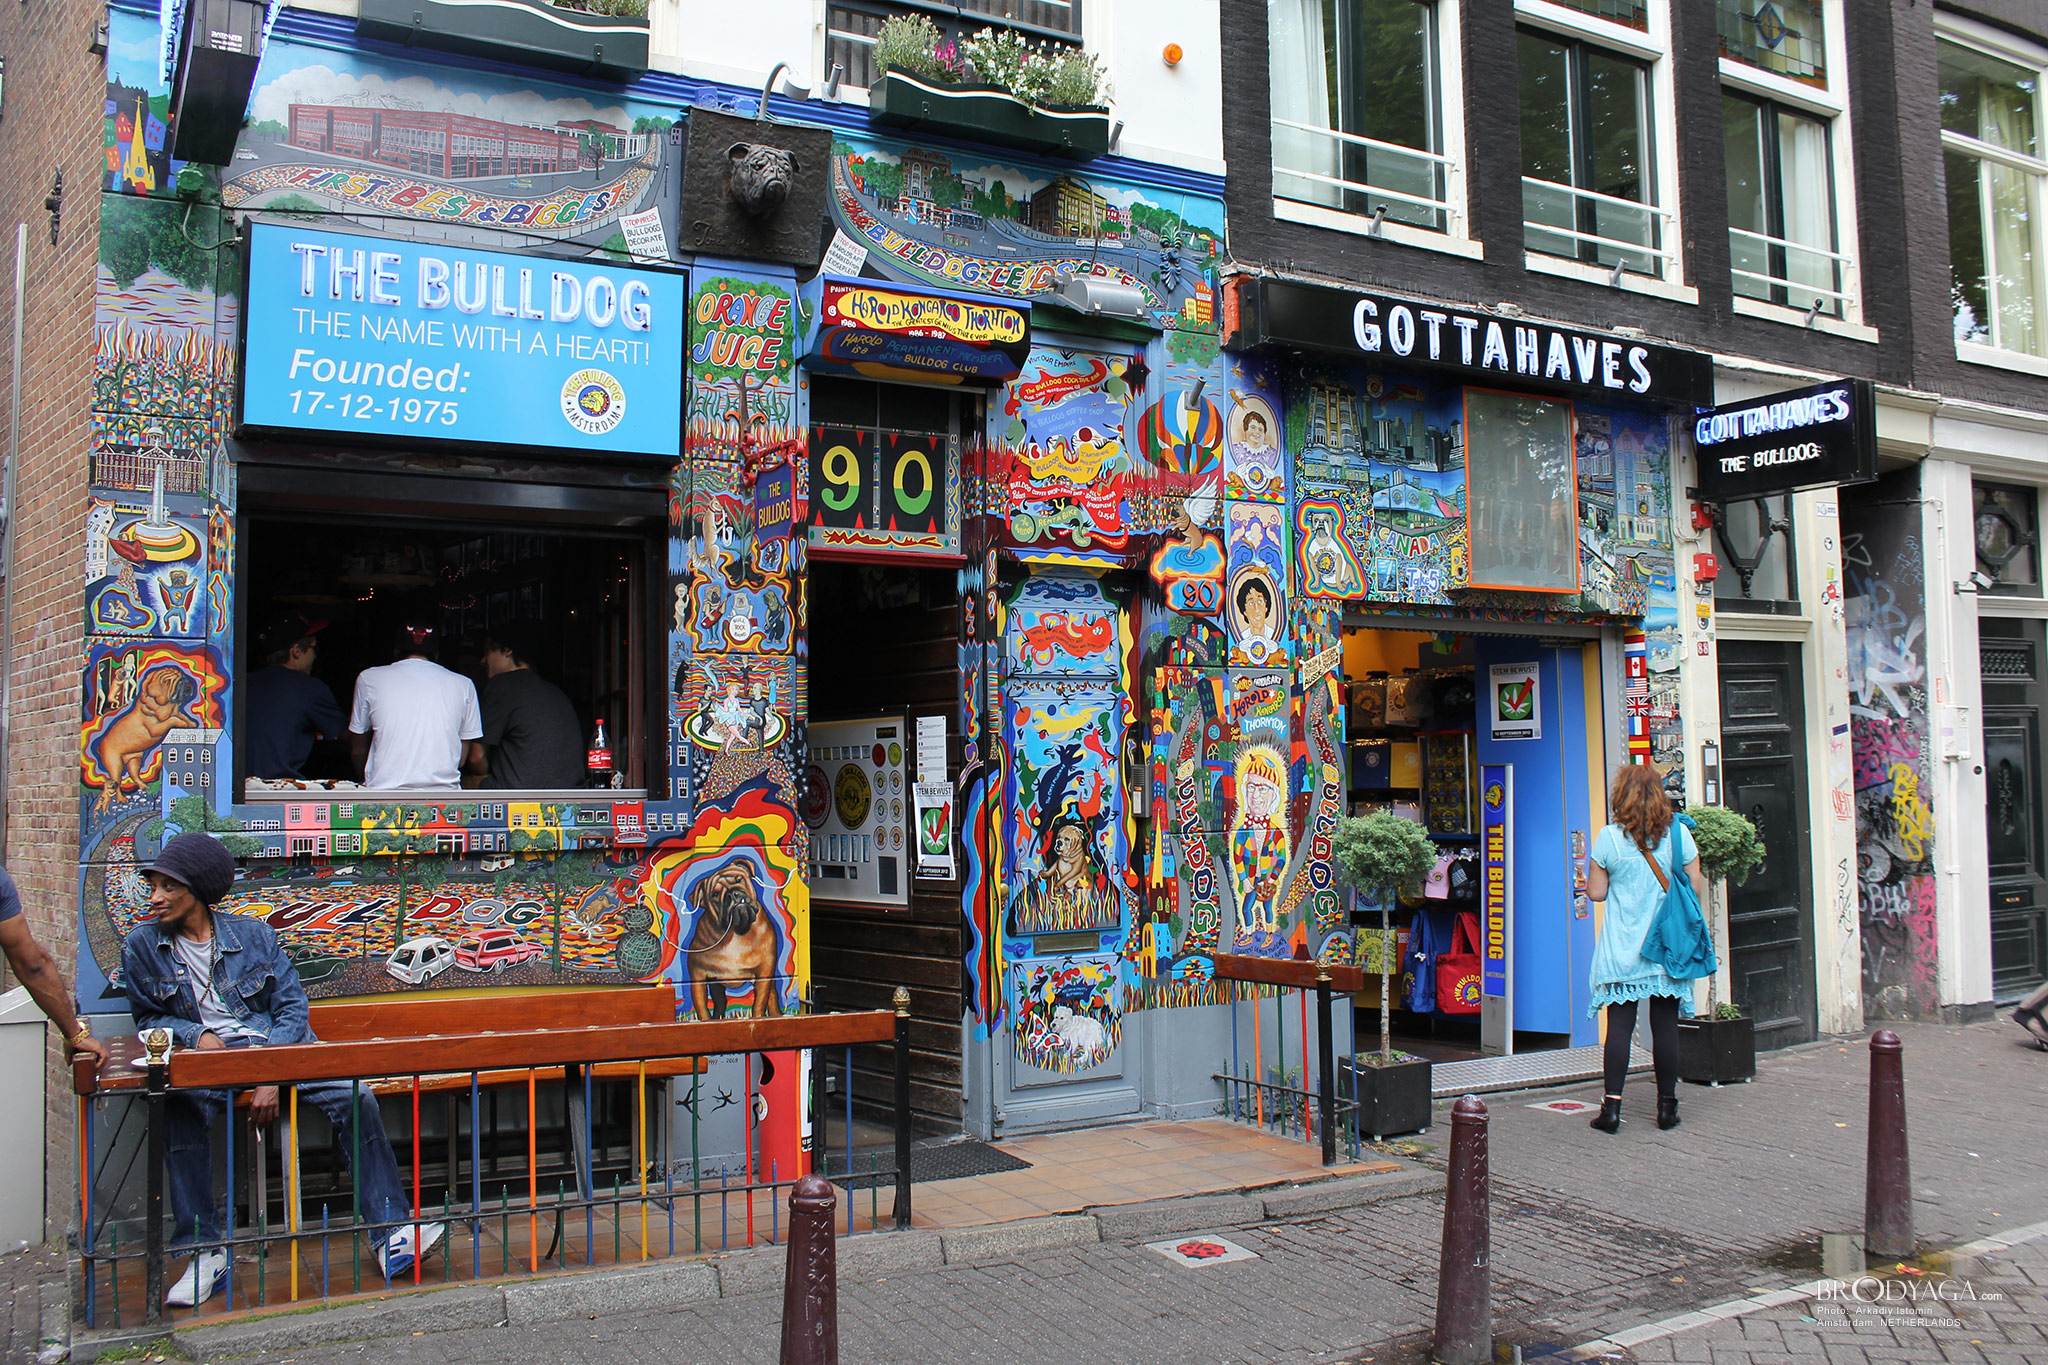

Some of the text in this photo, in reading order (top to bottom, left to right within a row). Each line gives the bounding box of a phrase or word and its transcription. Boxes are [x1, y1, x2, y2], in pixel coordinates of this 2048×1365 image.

[388, 184, 487, 219] BEST
[477, 202, 499, 223] &
[499, 181, 628, 225] BIGGEST
[624, 213, 658, 227] STOP PRESS
[626, 223, 661, 237] BULLDOGS
[628, 234, 663, 247] DECORATE
[649, 244, 667, 254] HALL
[866, 223, 981, 282] BULLDOG
[290, 242, 651, 332] THE BULLDOG
[697, 292, 791, 331] ORANGE
[292, 307, 650, 365] THE NAME WITH A HEART!
[839, 333, 883, 347] HAROLD
[931, 330, 947, 340] 1987
[1353, 298, 1652, 394] GOTTAHAVES
[691, 329, 784, 371] JUICE
[886, 340, 1003, 365] PERMANENT MEMBER
[904, 354, 949, 369] BULLDOG
[952, 362, 979, 373] CLUB
[1041, 355, 1054, 363] OUR
[289, 348, 471, 393] Founded:
[1035, 377, 1063, 391] BULLDOG
[563, 370, 625, 401] THE BULLDOG
[289, 389, 459, 426] 17-12-1975
[565, 407, 621, 432] AMSTERDAM
[1695, 389, 1851, 446] GOTTAHAVES
[1719, 441, 1823, 474] THE BULLDOG
[768, 480, 781, 499] THE
[1009, 481, 1032, 493] BULLDOG
[758, 498, 791, 529] BULLDOG
[1378, 525, 1442, 559] CANADA
[1182, 580, 1215, 608] 90
[1698, 641, 1709, 655] 88
[1234, 678, 1253, 691] WORLD
[1243, 716, 1288, 735] THORNTON
[915, 787, 929, 796] STEM
[1176, 757, 1218, 935] BULLDOG
[1309, 761, 1338, 918] BULLDOG
[1486, 822, 1505, 961] THE BULLDOG
[404, 894, 546, 926] DOG
[1456, 974, 1482, 989] BULLDO
